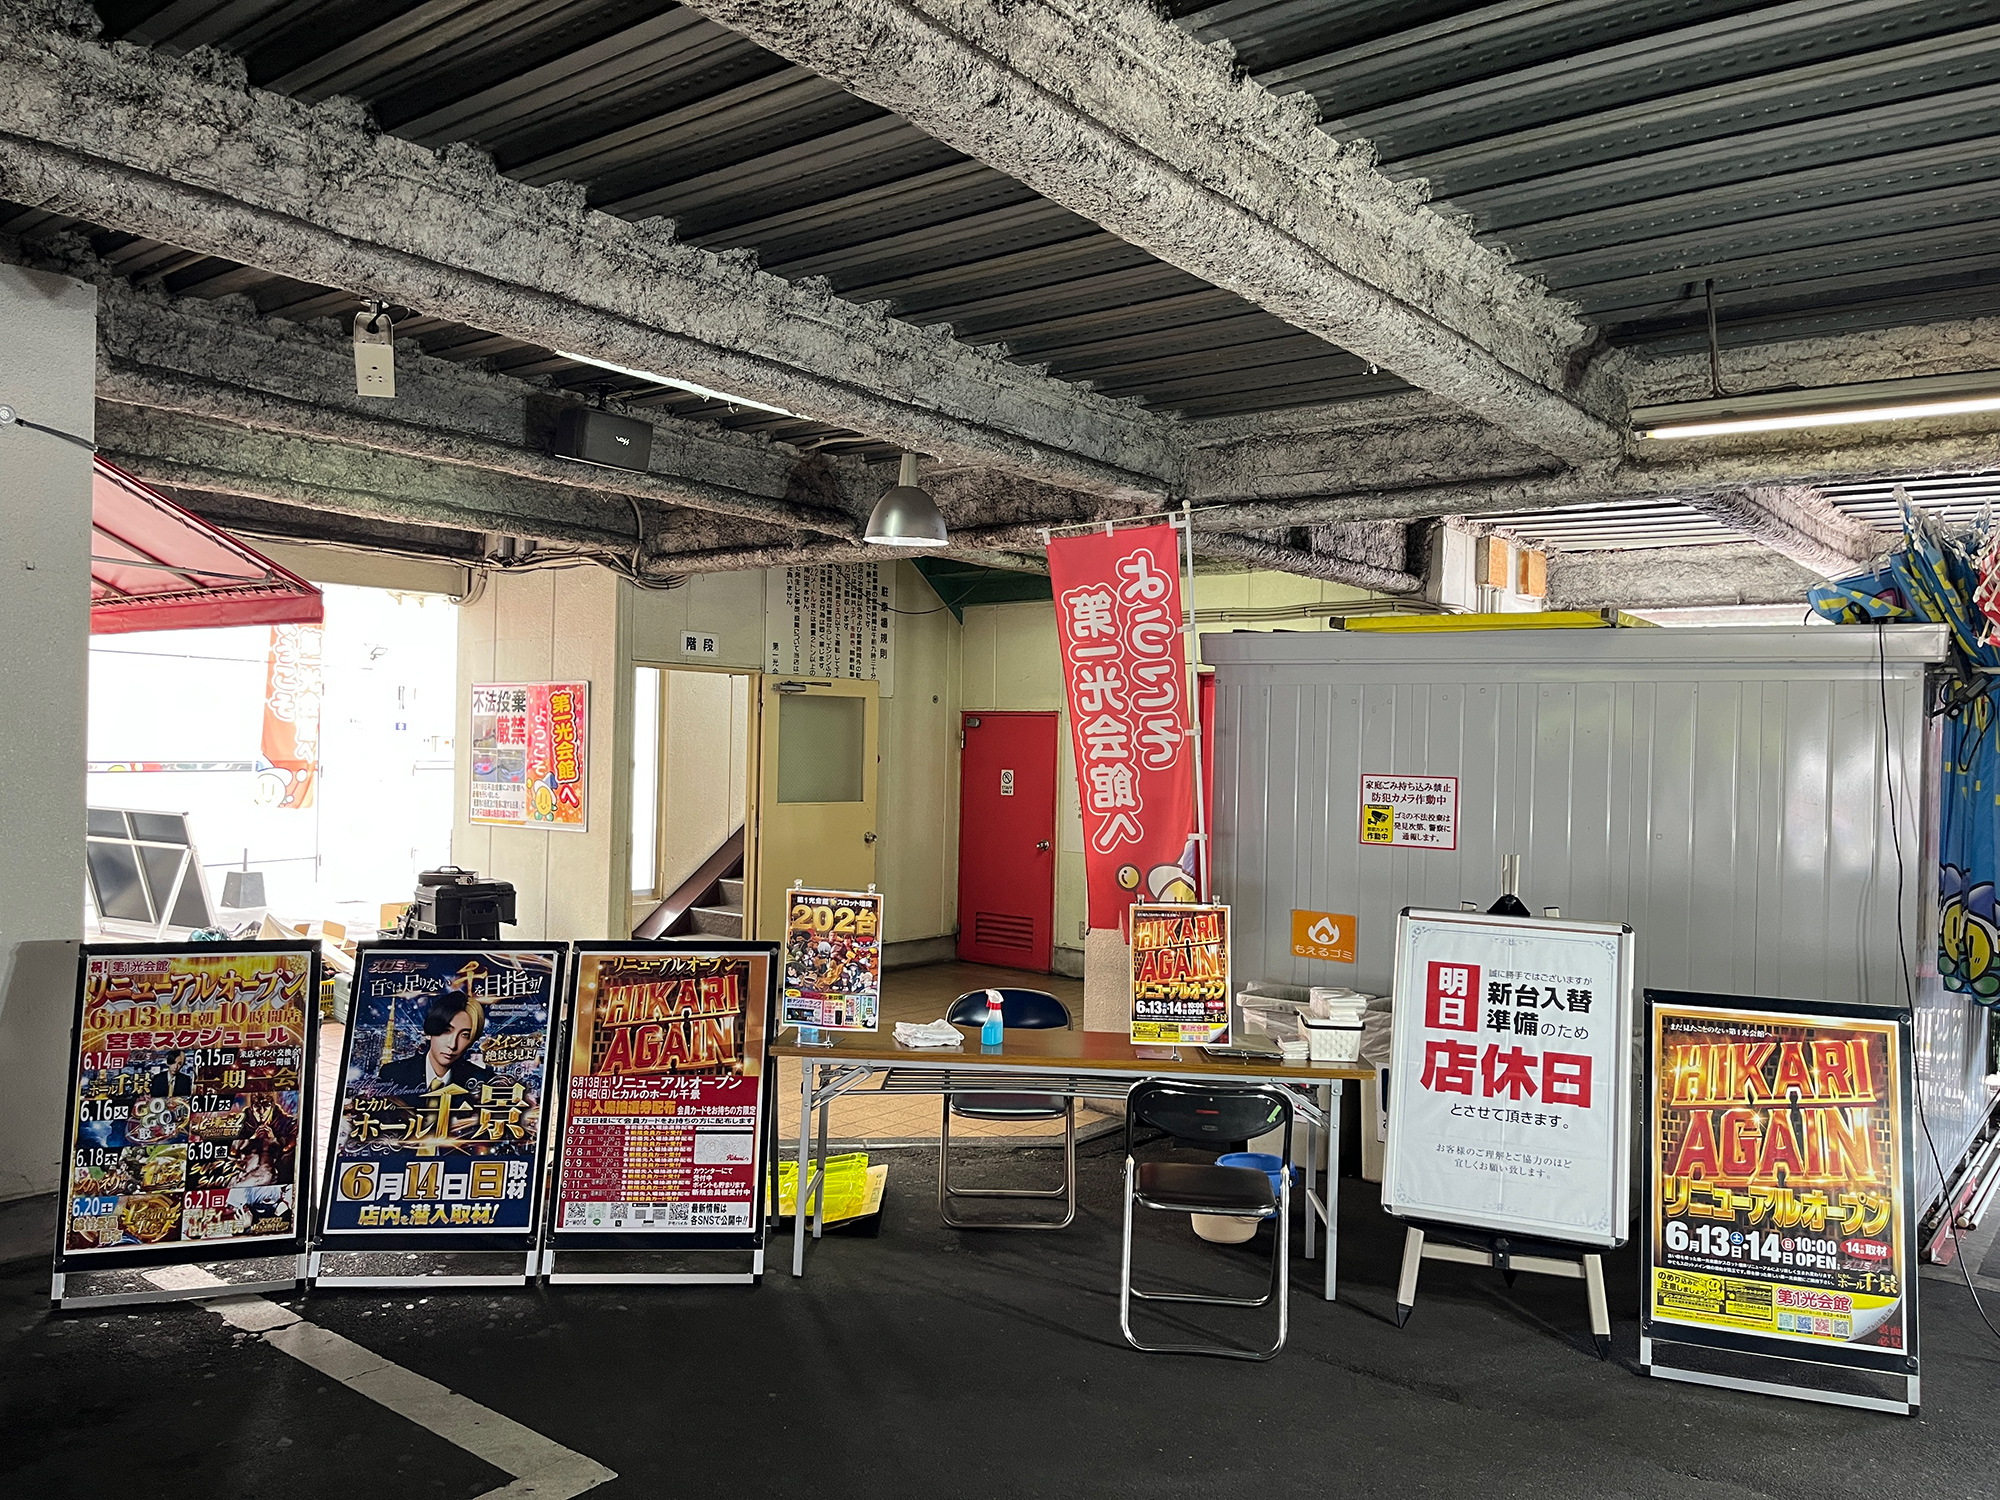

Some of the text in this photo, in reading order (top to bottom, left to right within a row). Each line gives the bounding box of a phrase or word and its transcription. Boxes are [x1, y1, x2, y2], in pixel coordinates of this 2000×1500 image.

[686, 636, 714, 652] 階段
[473, 690, 526, 713] 不法投棄
[496, 715, 526, 745] 厳禁
[532, 709, 549, 776] ようこそ
[552, 694, 578, 806] 第一光会館へ
[1366, 780, 1451, 793] 家庭ごみ持ち込み禁止
[1371, 793, 1447, 806] 防犯カメラ作動中
[1394, 812, 1451, 822] ゴミの不法投棄は
[1394, 822, 1451, 832] 発見次第、警察に
[1367, 833, 1389, 841] 作動中
[1402, 833, 1440, 842] 通報します。
[790, 904, 877, 937] 202台
[1137, 914, 1221, 951] HIKARI
[1295, 944, 1352, 960] もえるゴミ
[112, 960, 170, 973] 第1光会館
[613, 956, 738, 972] リニューアルオープン
[1138, 945, 1224, 983] AGAIN
[1488, 968, 1593, 986] 誠に勝手ではございますが
[88, 969, 308, 1009] リニューアルオープン
[602, 974, 741, 1027] HIKARI
[1135, 980, 1226, 1000] リニューアルオープン
[1438, 967, 1469, 1027] 明日
[1486, 981, 1593, 1014] 新台入替
[1486, 1009, 1589, 1040] 準備のため
[1670, 1023, 1773, 1038] まだ見たことのない第1光会館へ
[106, 1027, 288, 1050] 営業スケジュール
[597, 1015, 738, 1076] AGAIN
[485, 1049, 537, 1063] 絶景を見よ!
[195, 1067, 298, 1089] 一期一会
[1420, 1039, 1592, 1108] 店休日
[1671, 1039, 1877, 1107] HIKARI
[1450, 1103, 1569, 1130] とさせて頂きます。
[1436, 1143, 1573, 1169] お客様のご理解とご協力のほど
[1674, 1106, 1878, 1184] AGAIN
[1454, 1158, 1552, 1180] 宜しくお願い致します。
[357, 1203, 499, 1226] 店内を潜入取材!
[691, 1203, 727, 1213] 最新情報は
[1664, 1174, 1891, 1237] リニューアルオープン
[1794, 1237, 1837, 1255] 10:00
[1795, 1252, 1837, 1270] OPEN
[1777, 1288, 1851, 1313] 第1光会館
